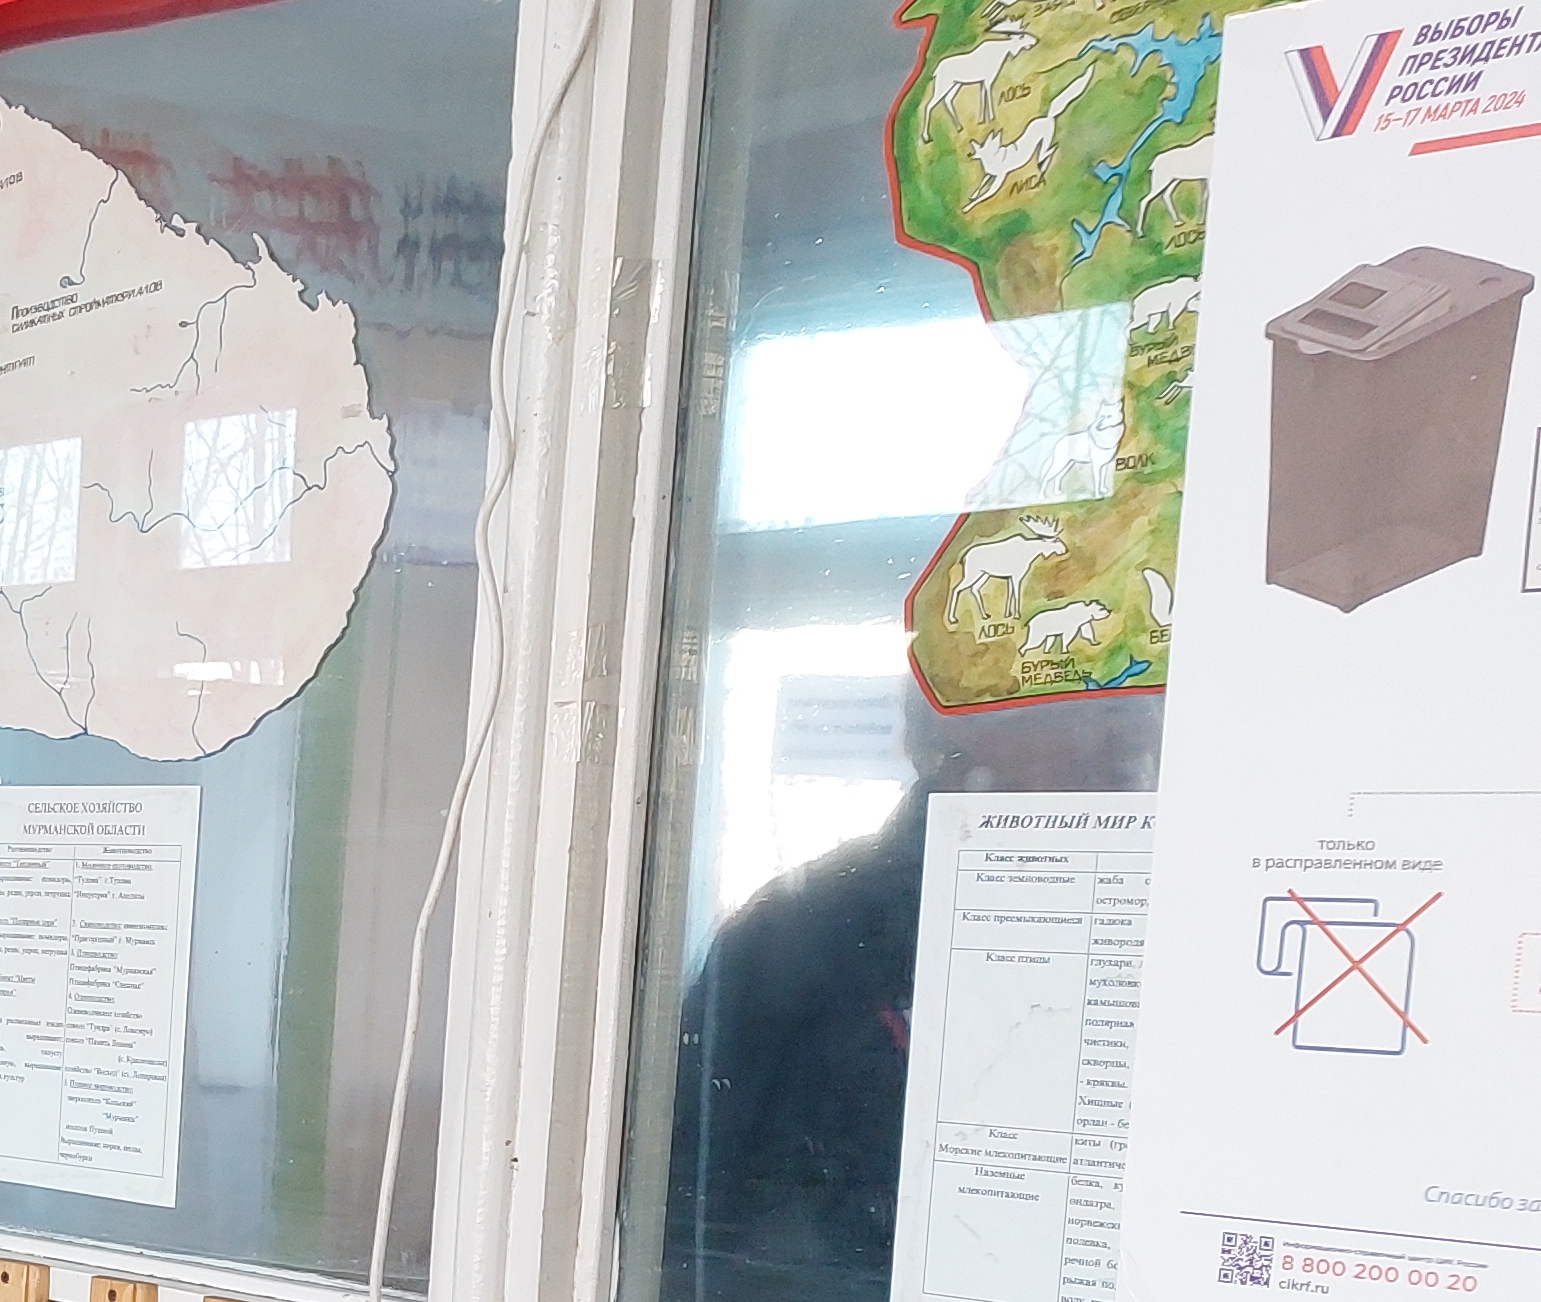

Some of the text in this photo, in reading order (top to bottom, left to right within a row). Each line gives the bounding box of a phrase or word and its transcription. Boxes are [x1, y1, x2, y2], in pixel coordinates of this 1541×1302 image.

[1412, 6, 1524, 47] ВЫБОРЫ
[1385, 70, 1484, 106] РОССИИ
[1420, 97, 1481, 125] МАРТА
[1482, 89, 1526, 114] 2024
[1010, 173, 1046, 196] ЛИСА
[1115, 452, 1157, 471] ВОЛК
[978, 622, 1015, 640] ЛОСЬ
[1021, 656, 1075, 674] БУРЫЙ
[1021, 670, 1092, 687] МЕДВЕДЬ
[27, 800, 142, 814] СЕЛЬСКОЕ ХОЗЯЙСТВО
[22, 822, 145, 836] МУРМАНСКОЙ ОБЛАСТИ
[978, 812, 1090, 829] ЖИВОТНЫЙ
[1092, 814, 1138, 829] МИР
[1317, 839, 1375, 851] только
[1252, 856, 1444, 873] в расправленном виде
[1096, 897, 1149, 908] остромор
[1423, 1185, 1514, 1211] Спасибо
[1282, 1255, 1478, 1292] 8 800 200 00 20
